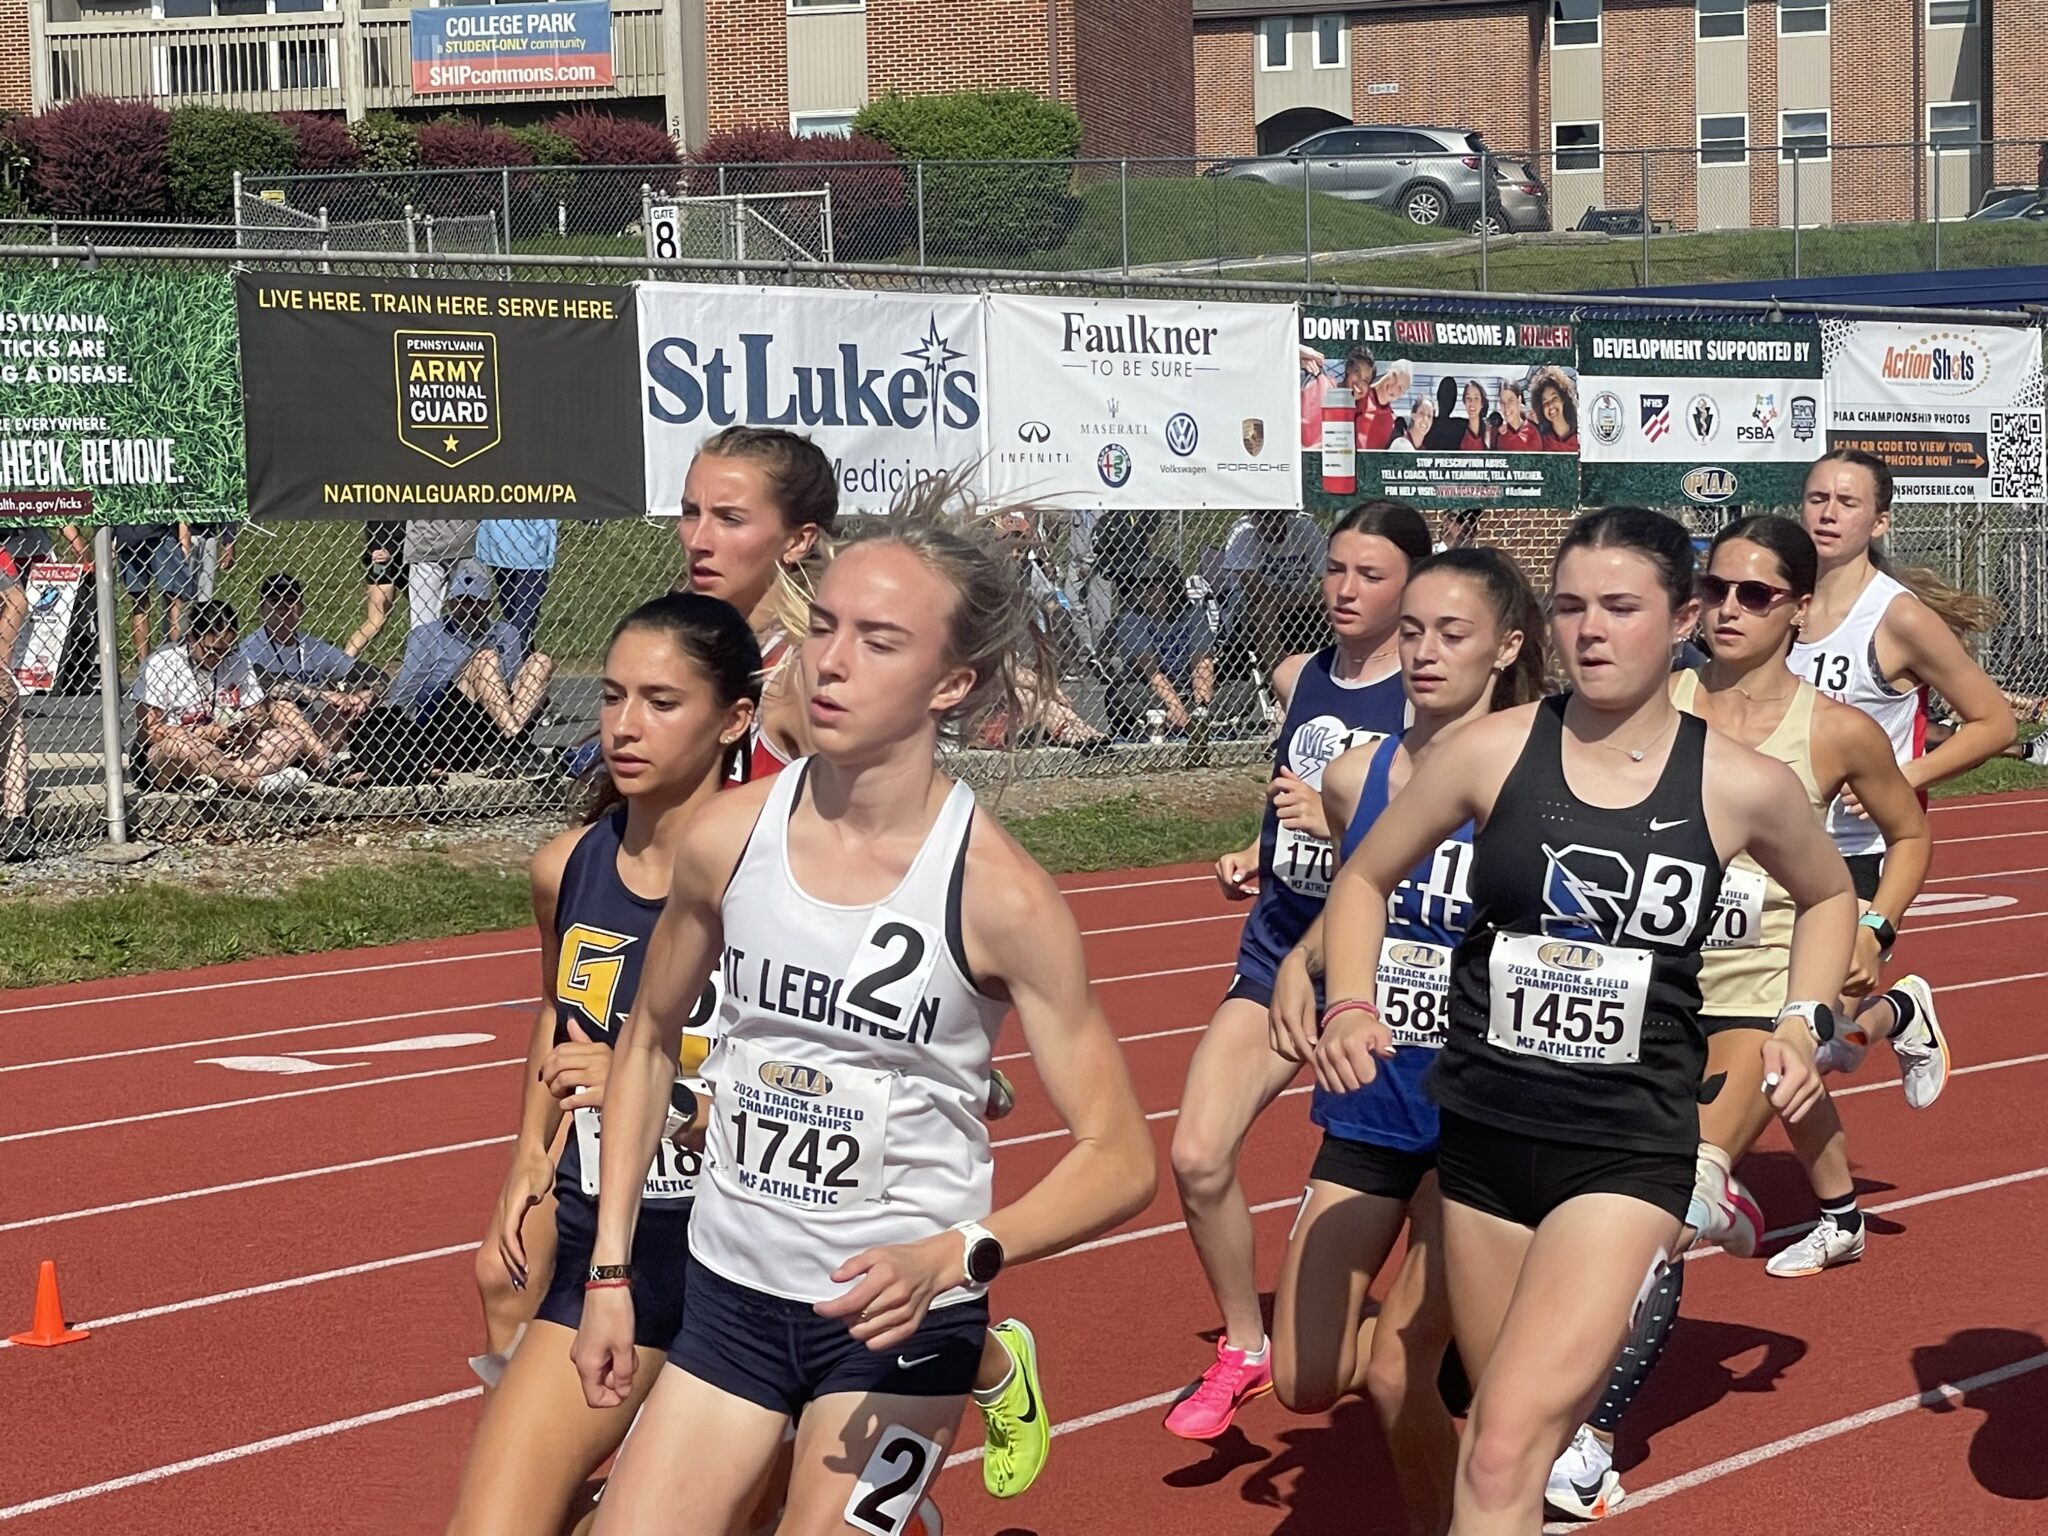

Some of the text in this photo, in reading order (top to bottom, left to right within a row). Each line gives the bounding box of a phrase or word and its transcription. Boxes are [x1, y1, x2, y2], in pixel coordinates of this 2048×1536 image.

[446, 13, 576, 38] COLLEGE PARK
[445, 38, 528, 54] STUDENT-ONLY
[530, 37, 586, 51] community
[430, 64, 595, 86] SHIPcommons.com
[653, 208, 674, 219] GATE
[656, 221, 677, 258] 8
[259, 288, 619, 320] LIVE HERE. TRAIN HERE. SERVE HERE.
[1061, 312, 1217, 356] Faulkner
[1303, 317, 1572, 348] DON'T LET PAIN BECOME A KILLER
[1, 339, 106, 358] TICKS ARE
[407, 339, 484, 352] PENNSYLVANIA
[1593, 338, 1810, 362] DEVELOPMENT SUPPORTED BY
[25, 365, 42, 384] A
[47, 365, 133, 384] DISEASE.
[408, 360, 484, 382] ARMY
[1091, 360, 1193, 377] TO BE SURE
[409, 384, 487, 400] NATIONAL
[647, 337, 736, 425] St
[411, 401, 488, 423] GUARD
[1833, 411, 1971, 424] PIAA CHAMPIONSHIP PHOTOS
[15, 417, 111, 431] EVERYWHERE.
[1080, 424, 1148, 435] MASERATI
[1737, 426, 1775, 440] PSBA
[1001, 453, 1070, 463] INFINITI
[1877, 441, 1902, 452] CODE
[1905, 441, 1918, 452] TO
[1919, 442, 1946, 453] VIEW
[1949, 442, 1974, 453] YOUR
[0, 438, 185, 487] HECK. REMOVE.
[1160, 464, 1207, 475] Volkswagen
[1217, 463, 1291, 472] PORSCHE
[1417, 458, 1433, 468] STOP
[1885, 455, 1923, 466] PHOTOS
[1925, 456, 1952, 466] NOW!
[1381, 470, 1397, 479] TELL
[1428, 470, 1444, 480] TELL
[1490, 471, 1506, 480] TELL
[1689, 472, 1733, 494] PIAA
[324, 484, 577, 504] NATIONALGUARD.COM/PA
[1813, 652, 1850, 691] 13
[1288, 842, 1333, 882] 170
[1640, 864, 1693, 937] 3
[1725, 890, 1749, 900] FIELD
[1543, 944, 1600, 969] PIAA
[846, 922, 925, 1021] 2
[1392, 966, 1426, 980] TRACK
[1428, 973, 1436, 982] &
[1508, 963, 1629, 990] 2024 TRACK & FIELD
[1515, 976, 1618, 999] CHAMPIONSHIPS
[1506, 987, 1625, 1045] 1455
[1538, 1041, 1606, 1058] ATHLETIC
[765, 1062, 828, 1095] PIAA
[733, 1080, 864, 1121] 2024 TRACK & FIELD
[738, 1097, 852, 1132] CHAMPIONSHIPS
[731, 1110, 860, 1188] 1742
[760, 1178, 838, 1205] ATHLETIC
[853, 1437, 926, 1534] 2
